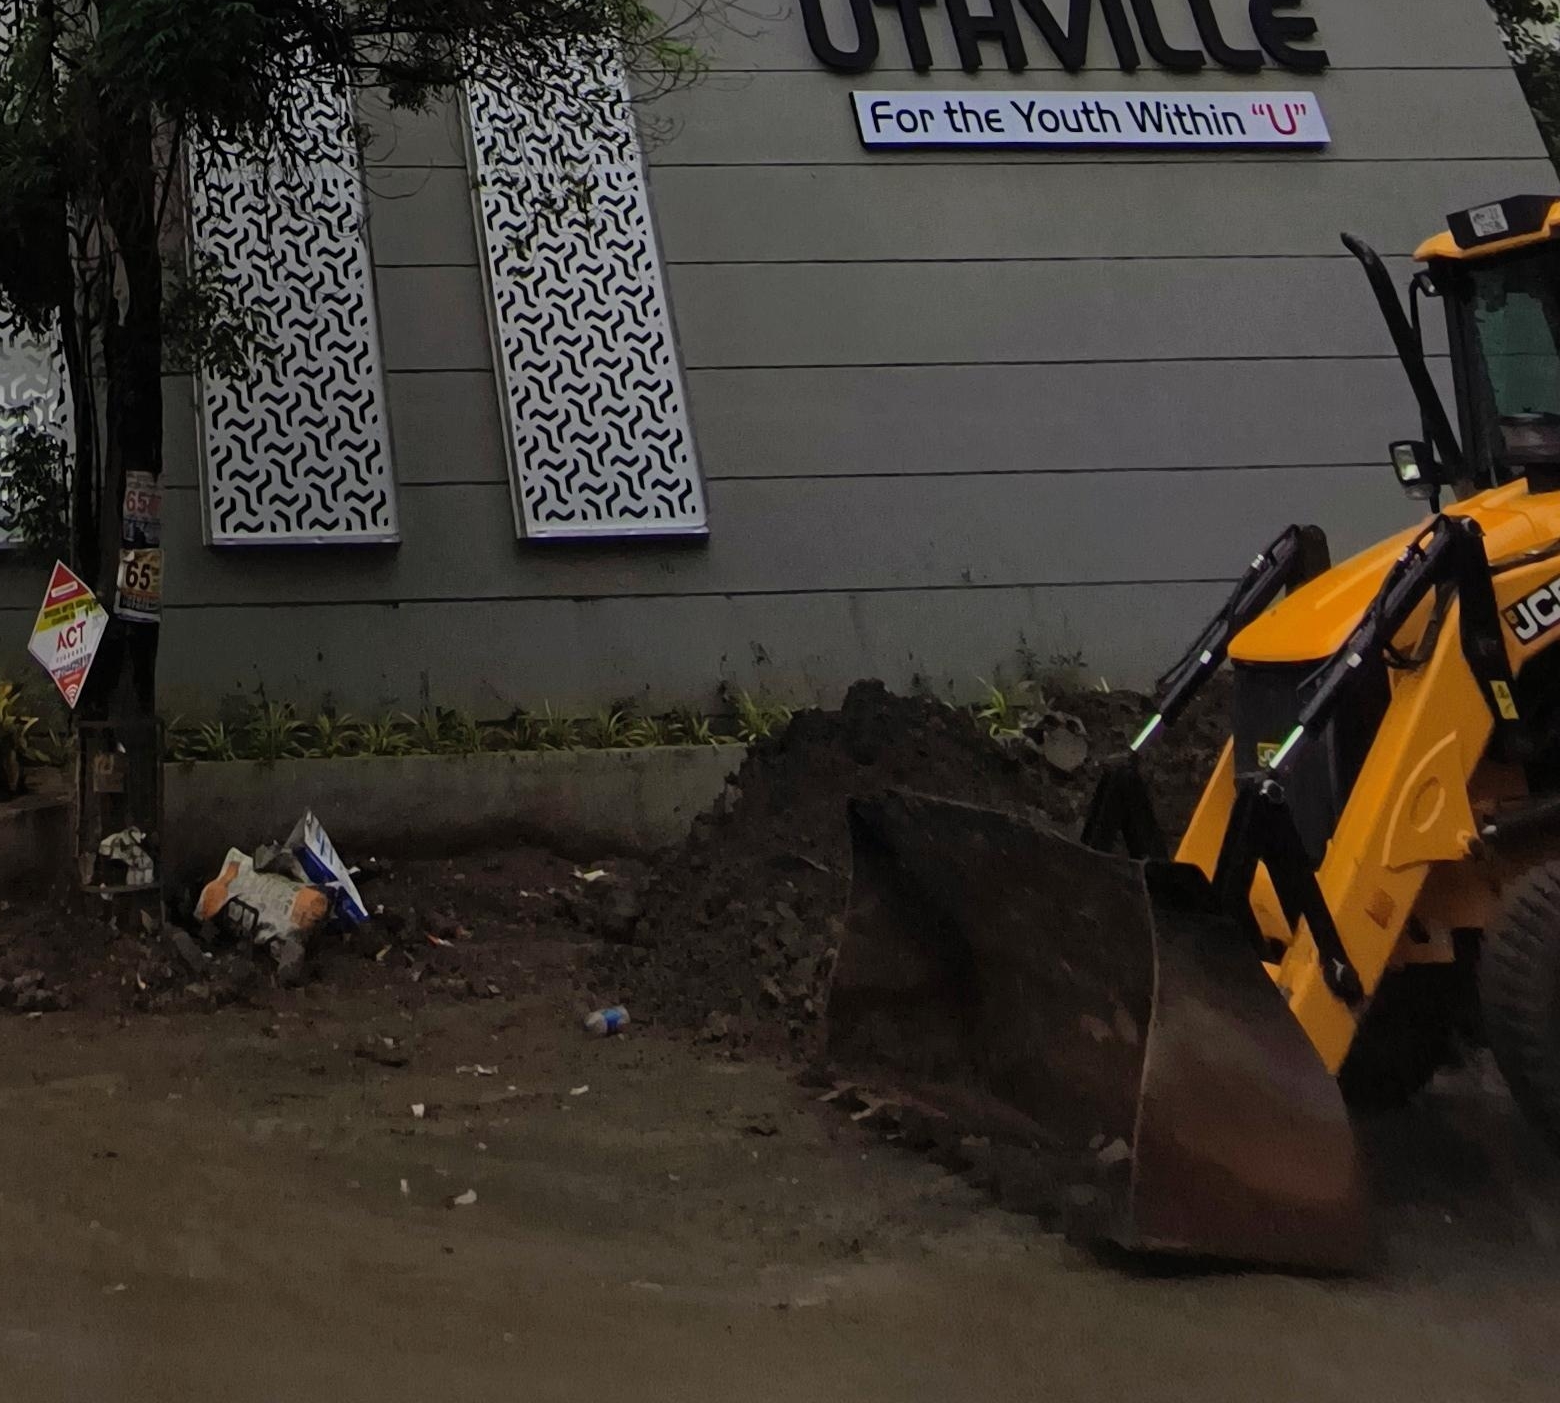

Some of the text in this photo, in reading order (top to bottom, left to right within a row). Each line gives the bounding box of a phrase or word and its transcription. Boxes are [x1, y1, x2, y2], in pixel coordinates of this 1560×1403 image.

[871, 101, 935, 134] For
[944, 101, 1004, 134] the
[1011, 100, 1122, 134] Youth
[1128, 101, 1246, 136] Within
[125, 560, 151, 590] 65
[56, 621, 86, 652] ACT
